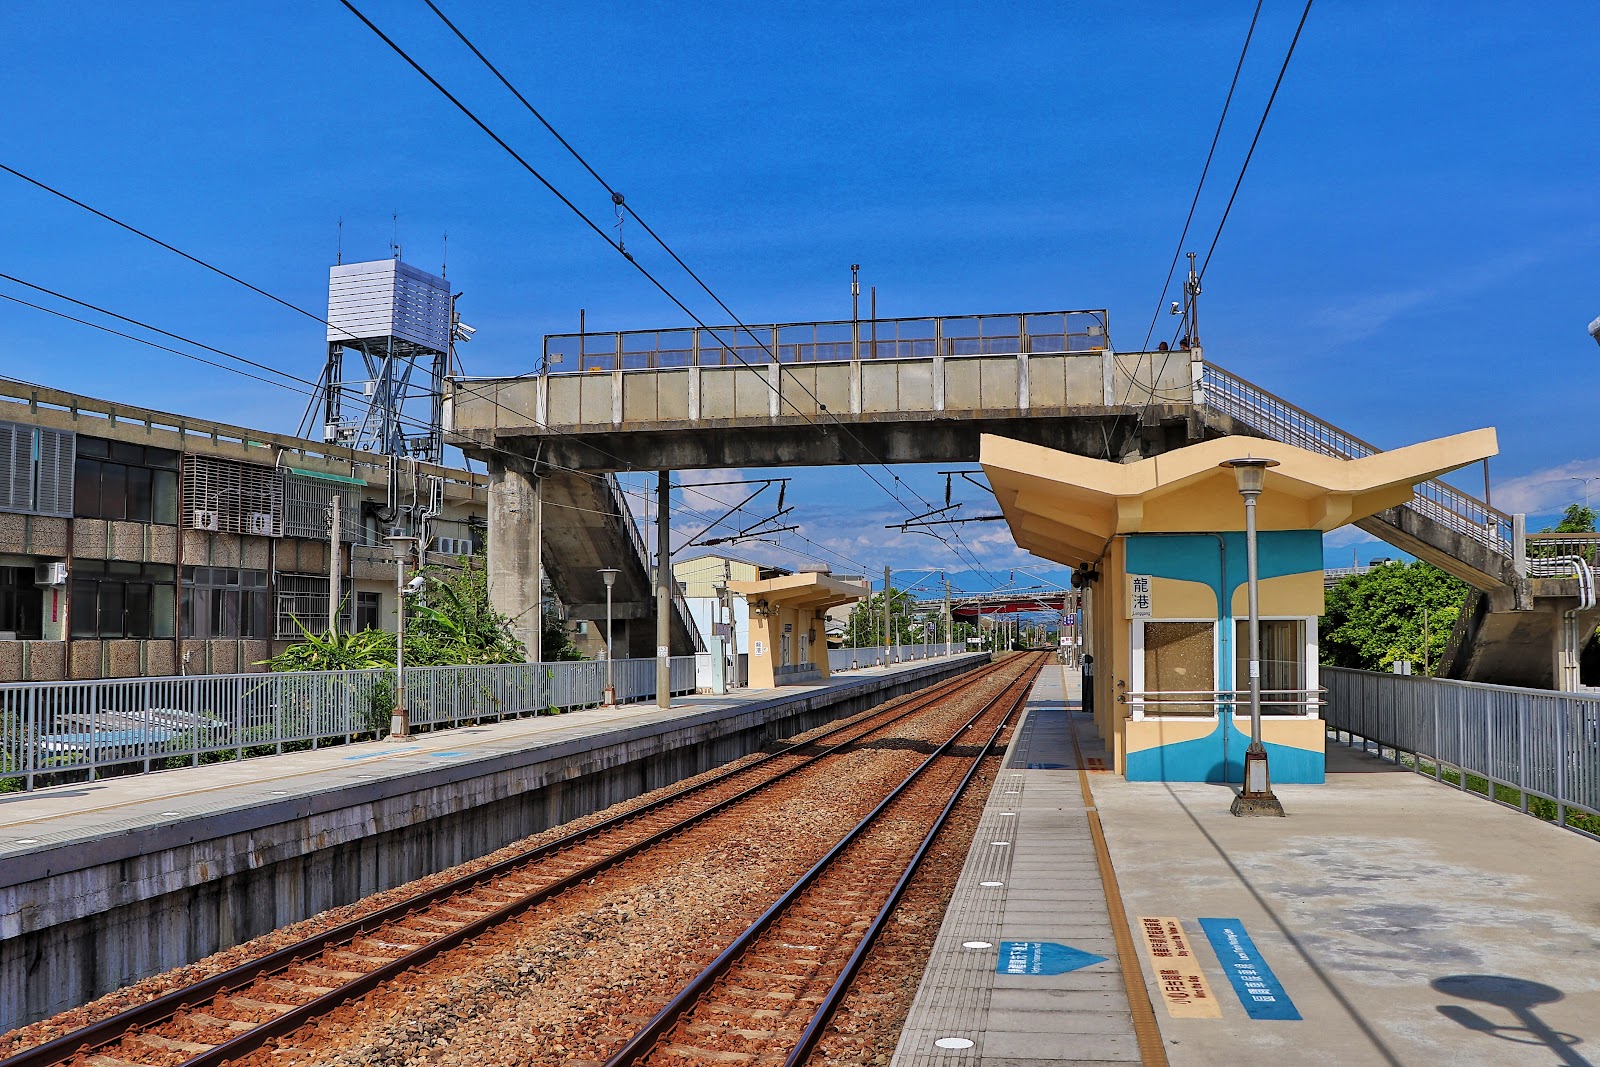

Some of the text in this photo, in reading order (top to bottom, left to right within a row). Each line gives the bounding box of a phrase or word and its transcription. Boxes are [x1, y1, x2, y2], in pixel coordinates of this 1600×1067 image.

[1133, 577, 1149, 609] 龍港
[1159, 969, 1192, 1005] 小心月台間隙
